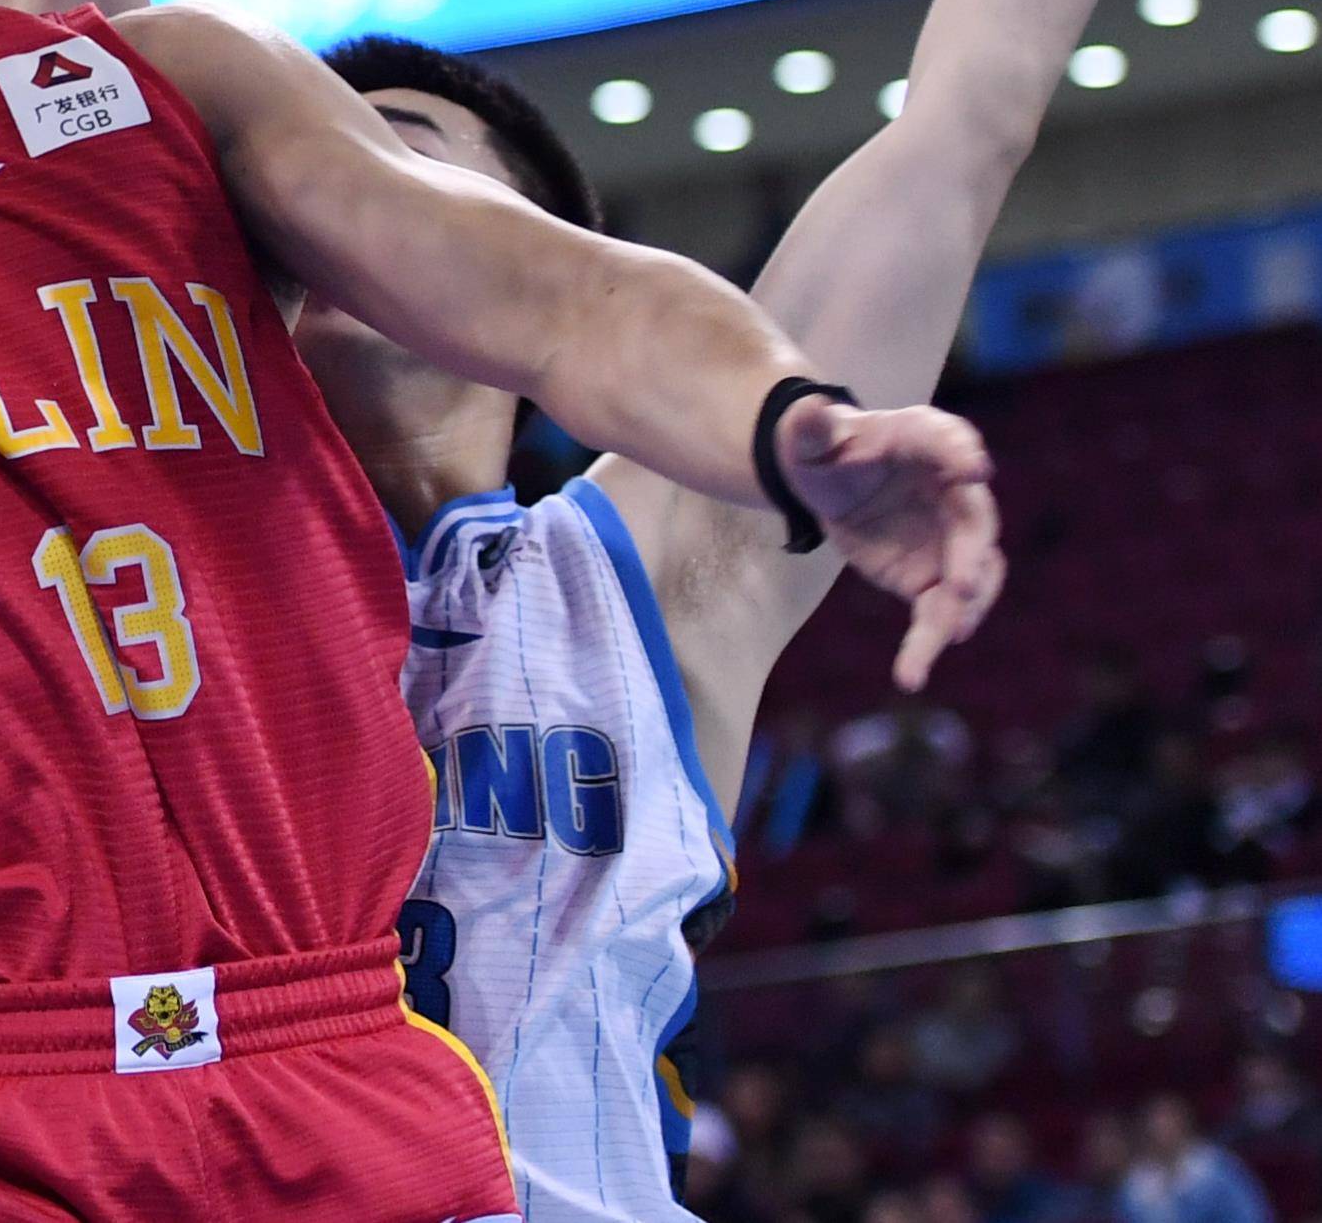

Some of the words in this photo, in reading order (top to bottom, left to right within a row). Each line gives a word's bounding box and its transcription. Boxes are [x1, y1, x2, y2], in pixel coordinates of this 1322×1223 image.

[35, 84, 120, 124] 广发银行
[59, 109, 113, 137] CGB
[31, 522, 201, 721] 13
